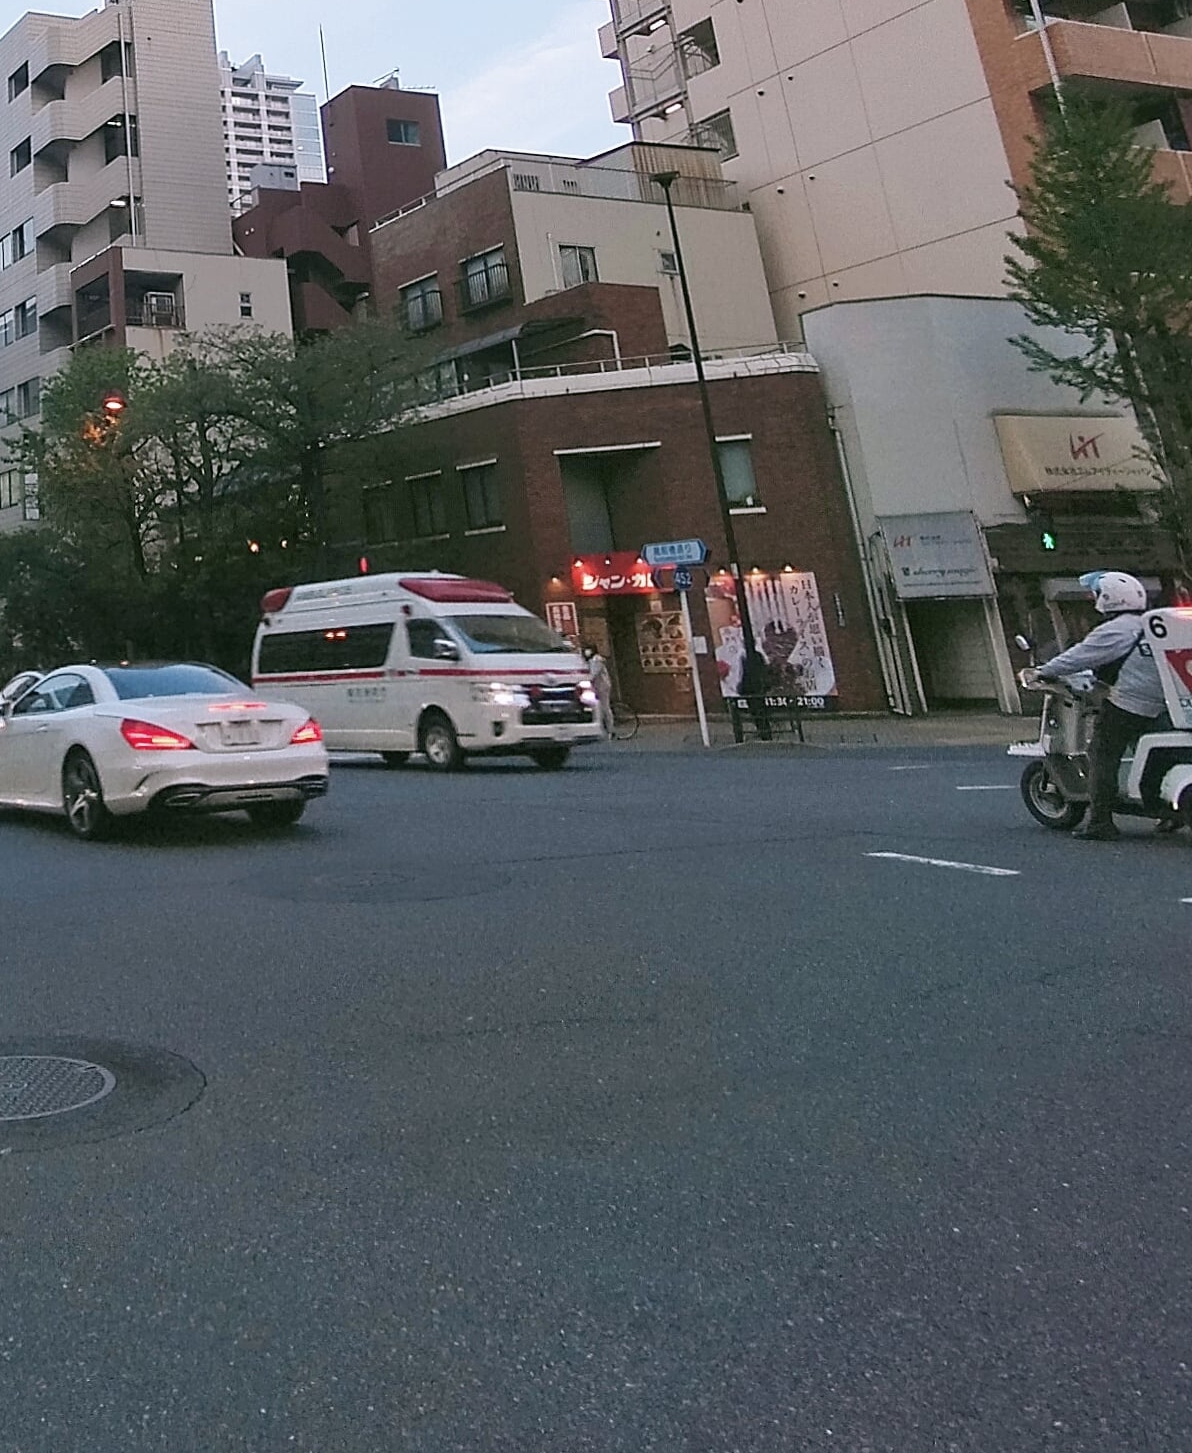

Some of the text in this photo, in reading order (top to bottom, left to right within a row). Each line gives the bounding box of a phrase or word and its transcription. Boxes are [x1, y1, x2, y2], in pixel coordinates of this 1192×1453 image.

[675, 571, 692, 585] 452
[1149, 615, 1168, 639] 6
[797, 697, 824, 708] 21:00
